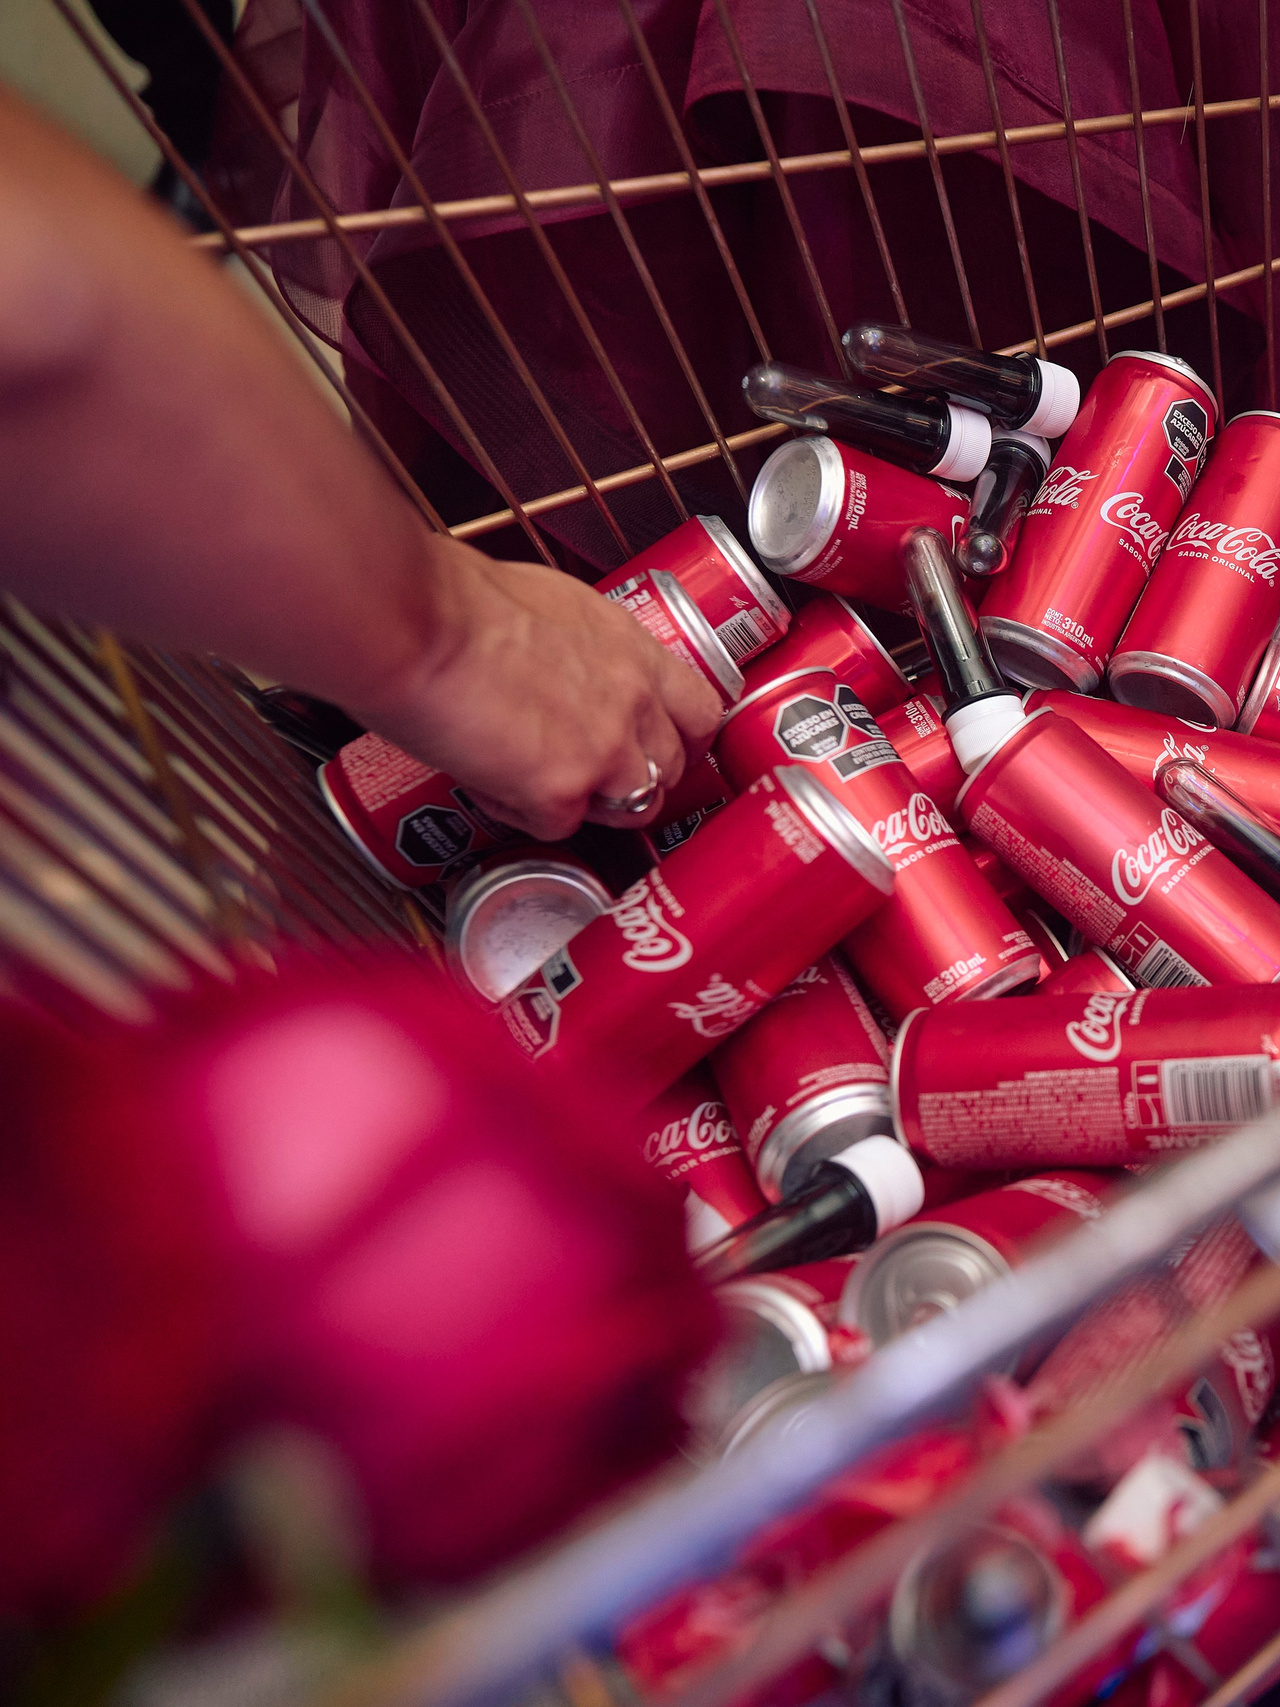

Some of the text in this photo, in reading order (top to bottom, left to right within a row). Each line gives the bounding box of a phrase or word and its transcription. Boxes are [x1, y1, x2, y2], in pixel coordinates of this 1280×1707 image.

[1173, 410, 1197, 437] EXCESO
[851, 488, 868, 515] 310
[846, 513, 860, 532] mL
[1119, 538, 1143, 565] SABOR
[1178, 551, 1255, 583] SABOR ORIGINAL
[1046, 608, 1063, 621] CONT.
[1044, 613, 1094, 648] NETO: 310 mL
[904, 705, 924, 725] 310
[896, 851, 926, 872] ABOR
[1161, 864, 1190, 895] SABOR
[941, 953, 987, 985] 310 mL
